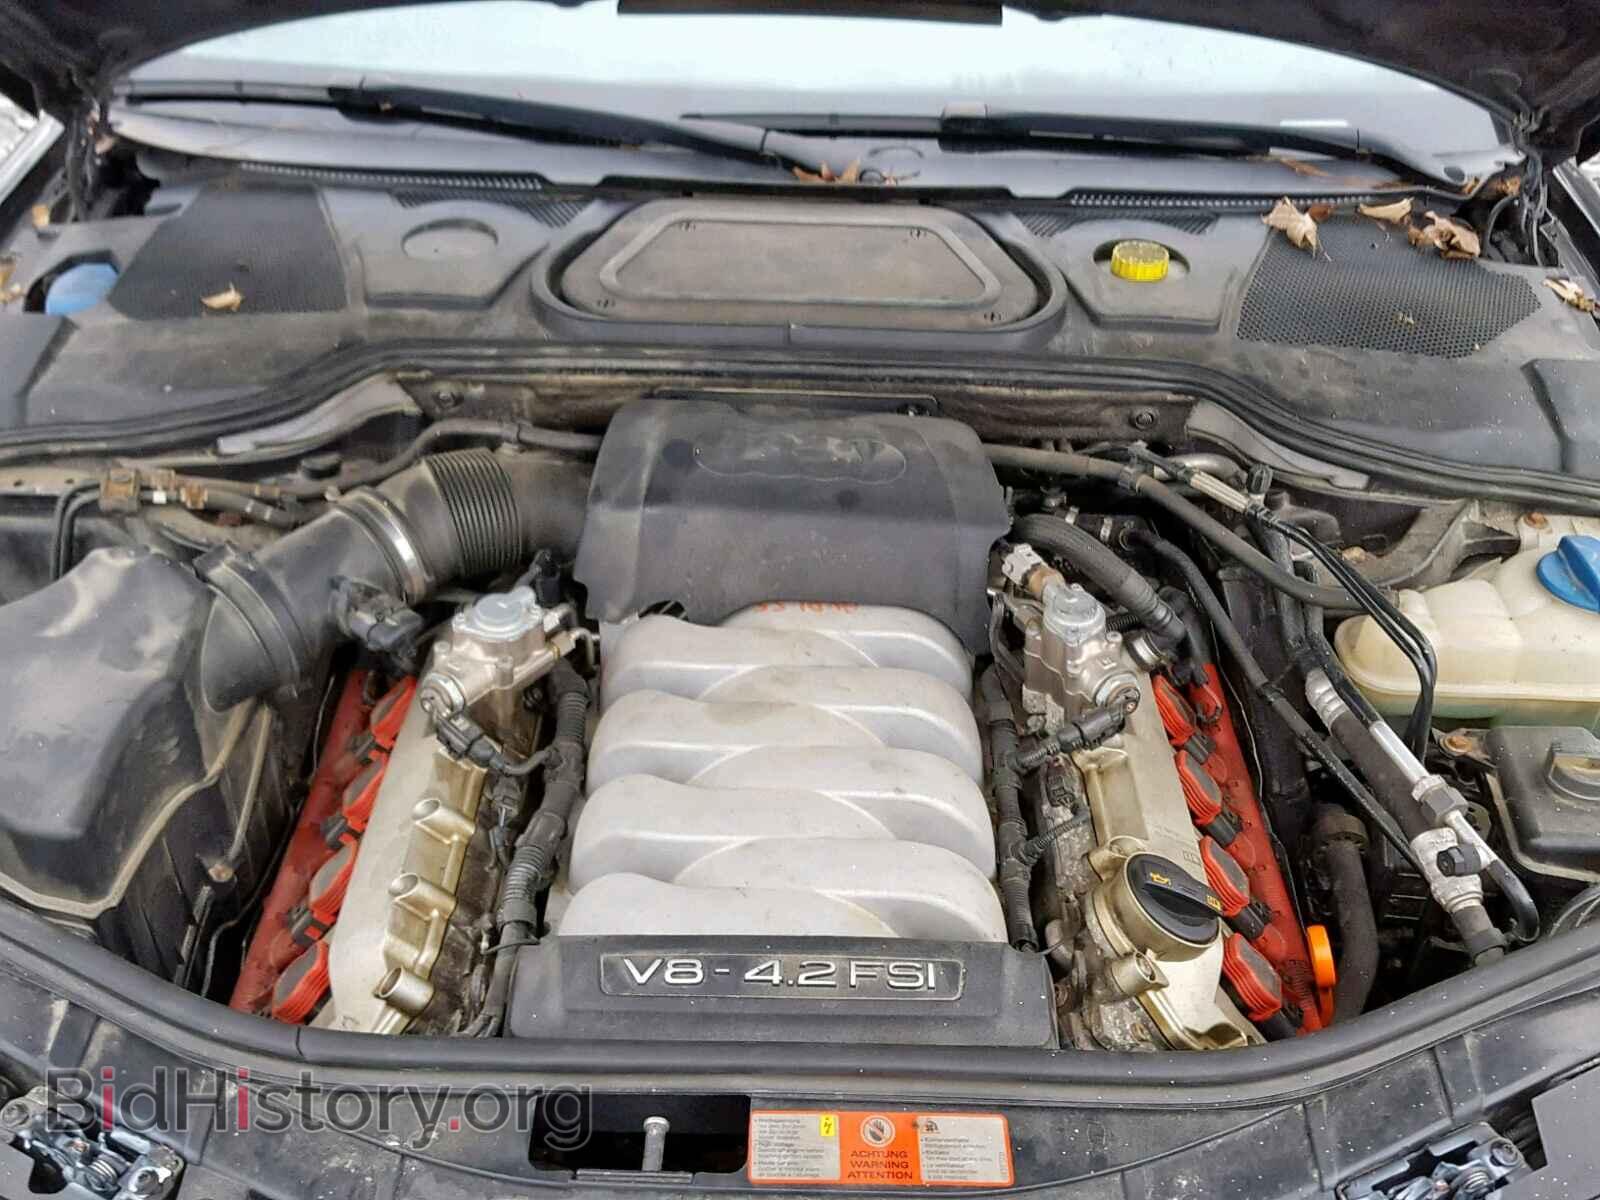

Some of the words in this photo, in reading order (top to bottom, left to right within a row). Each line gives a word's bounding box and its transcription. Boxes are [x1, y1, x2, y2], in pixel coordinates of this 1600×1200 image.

[624, 958, 704, 985] V8
[744, 960, 837, 987] 4.2
[850, 962, 936, 990] FSI
[850, 1150, 909, 1159] ACHTUNG
[849, 1160, 909, 1169] WARNING
[847, 1170, 913, 1179] ATTENTION
